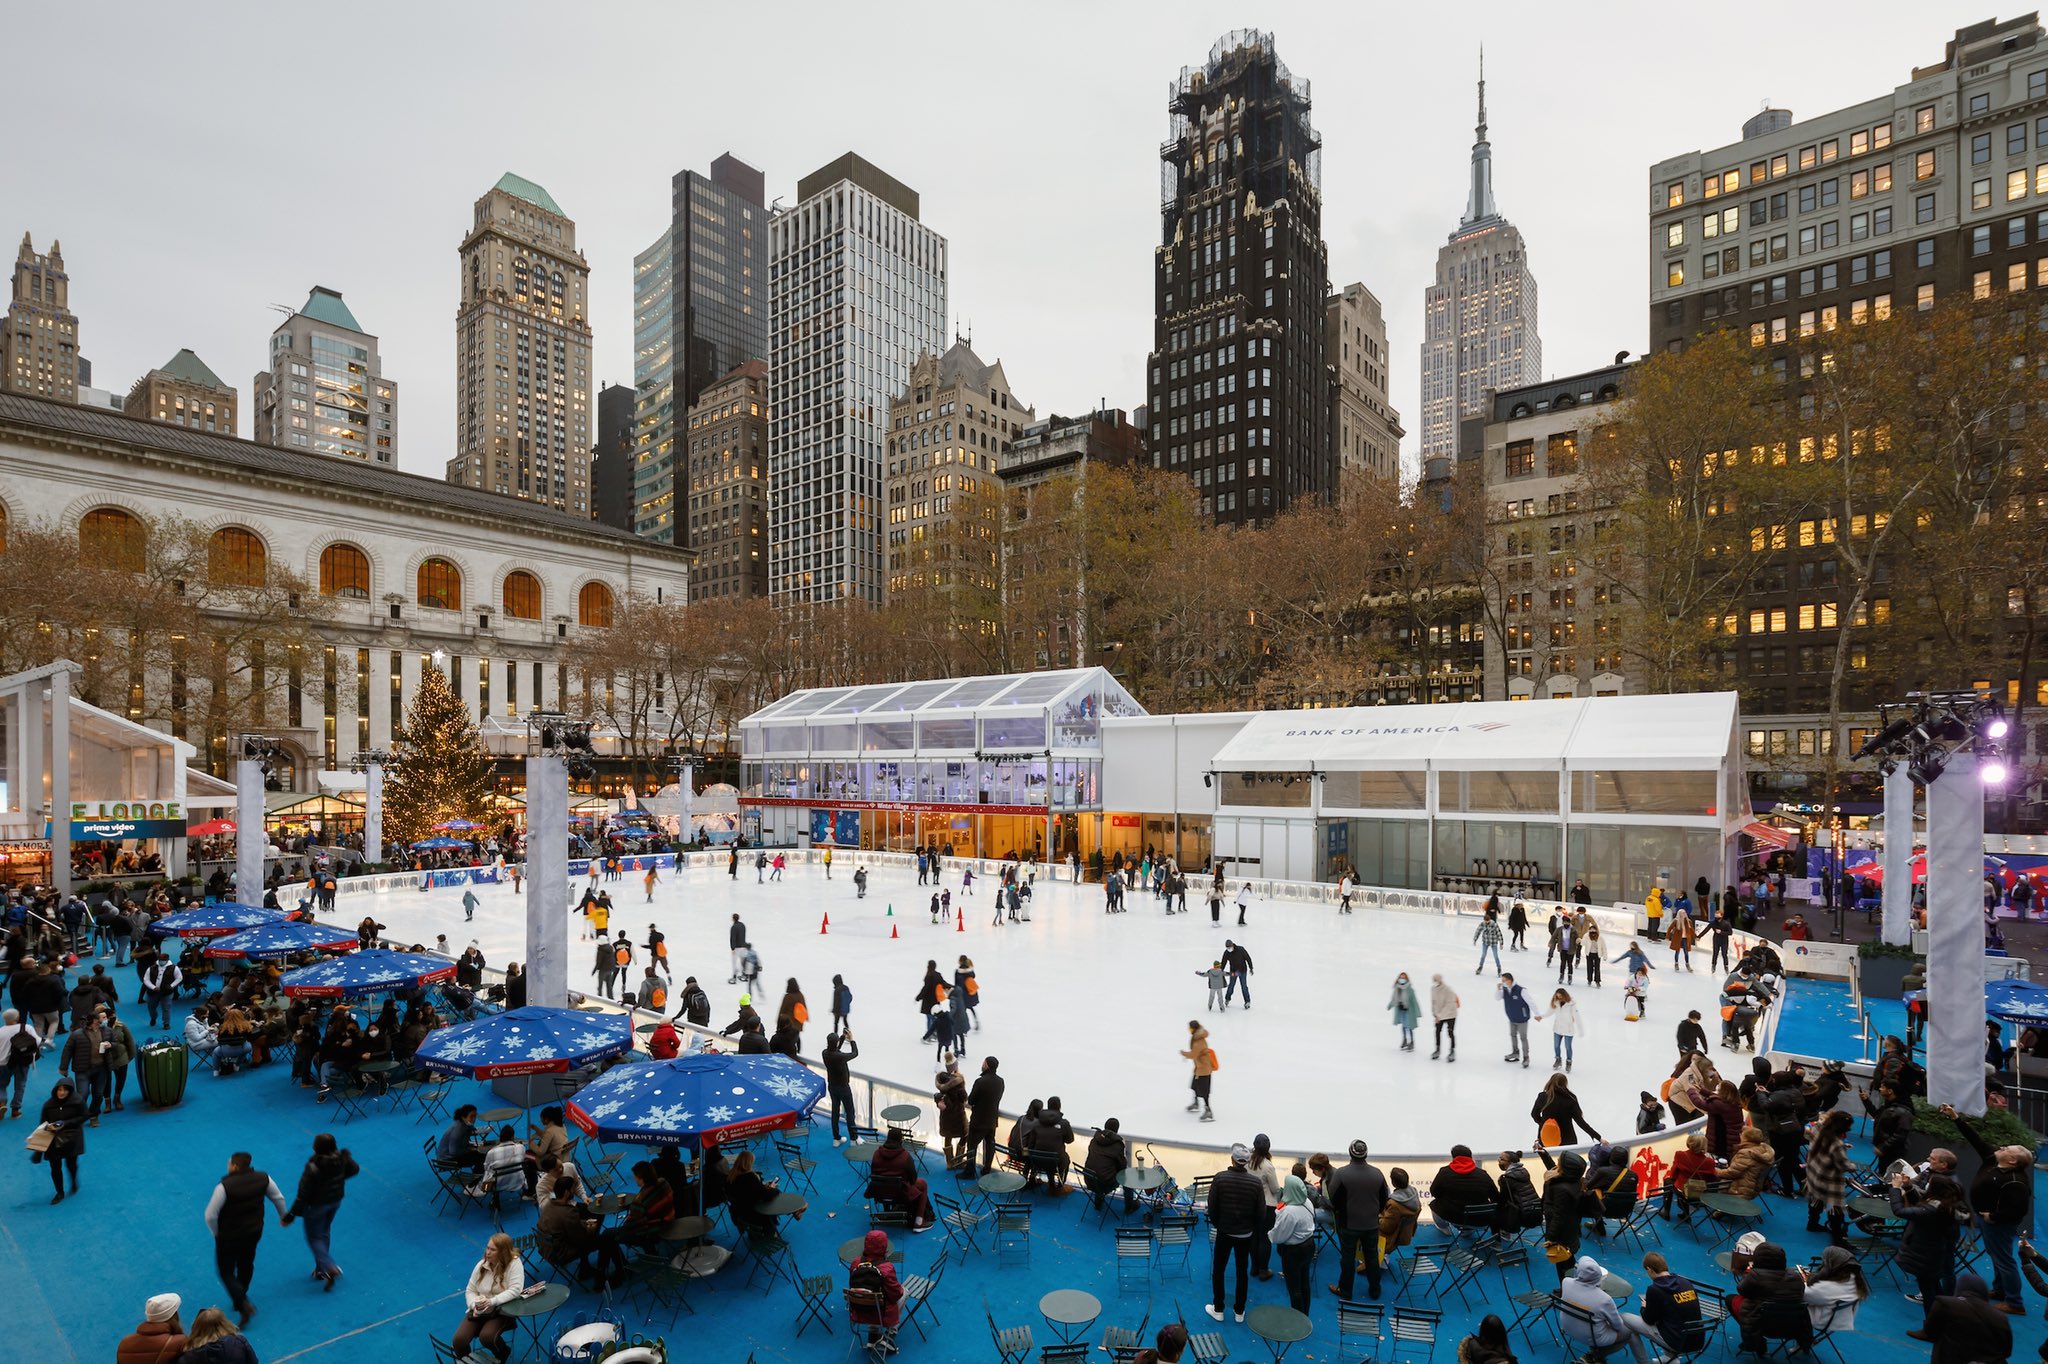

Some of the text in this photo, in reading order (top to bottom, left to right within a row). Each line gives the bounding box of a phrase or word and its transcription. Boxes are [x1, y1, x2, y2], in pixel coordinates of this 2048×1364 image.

[1286, 726, 1460, 737] BANK OF AMERICA
[99, 803, 180, 821] LODGE
[1783, 803, 1841, 813] FedEx Ofce
[84, 823, 135, 833] prime video
[358, 983, 385, 992] BRYANT
[425, 1061, 463, 1074] BRYANT PARK
[656, 1135, 680, 1143] PARK
